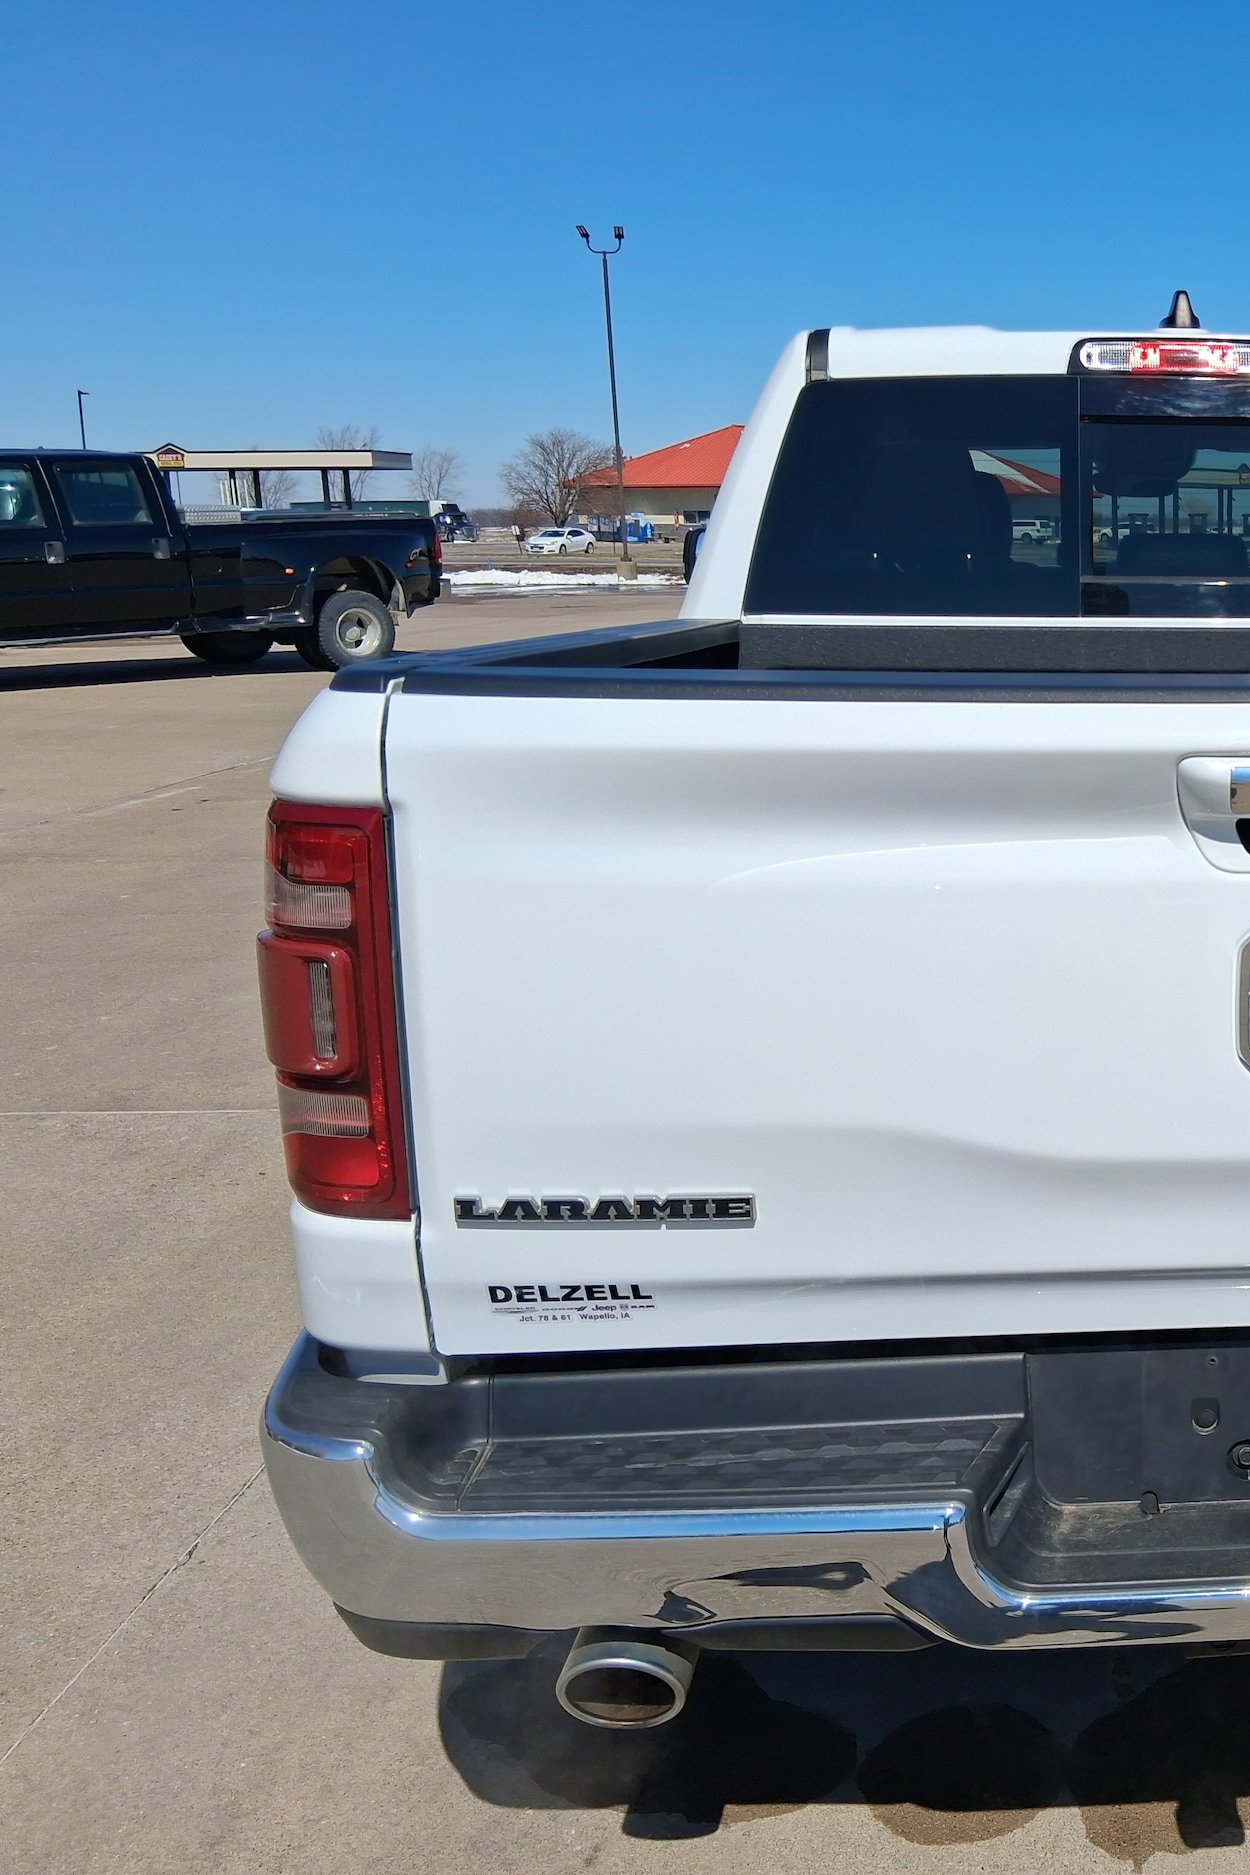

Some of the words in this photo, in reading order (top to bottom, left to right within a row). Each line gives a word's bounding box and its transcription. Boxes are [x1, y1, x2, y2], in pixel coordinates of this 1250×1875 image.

[454, 1194, 755, 1229] LARAMIE
[488, 1284, 653, 1303] DELZELL
[592, 1304, 617, 1312] Jeep
[519, 1315, 536, 1323] Jct.
